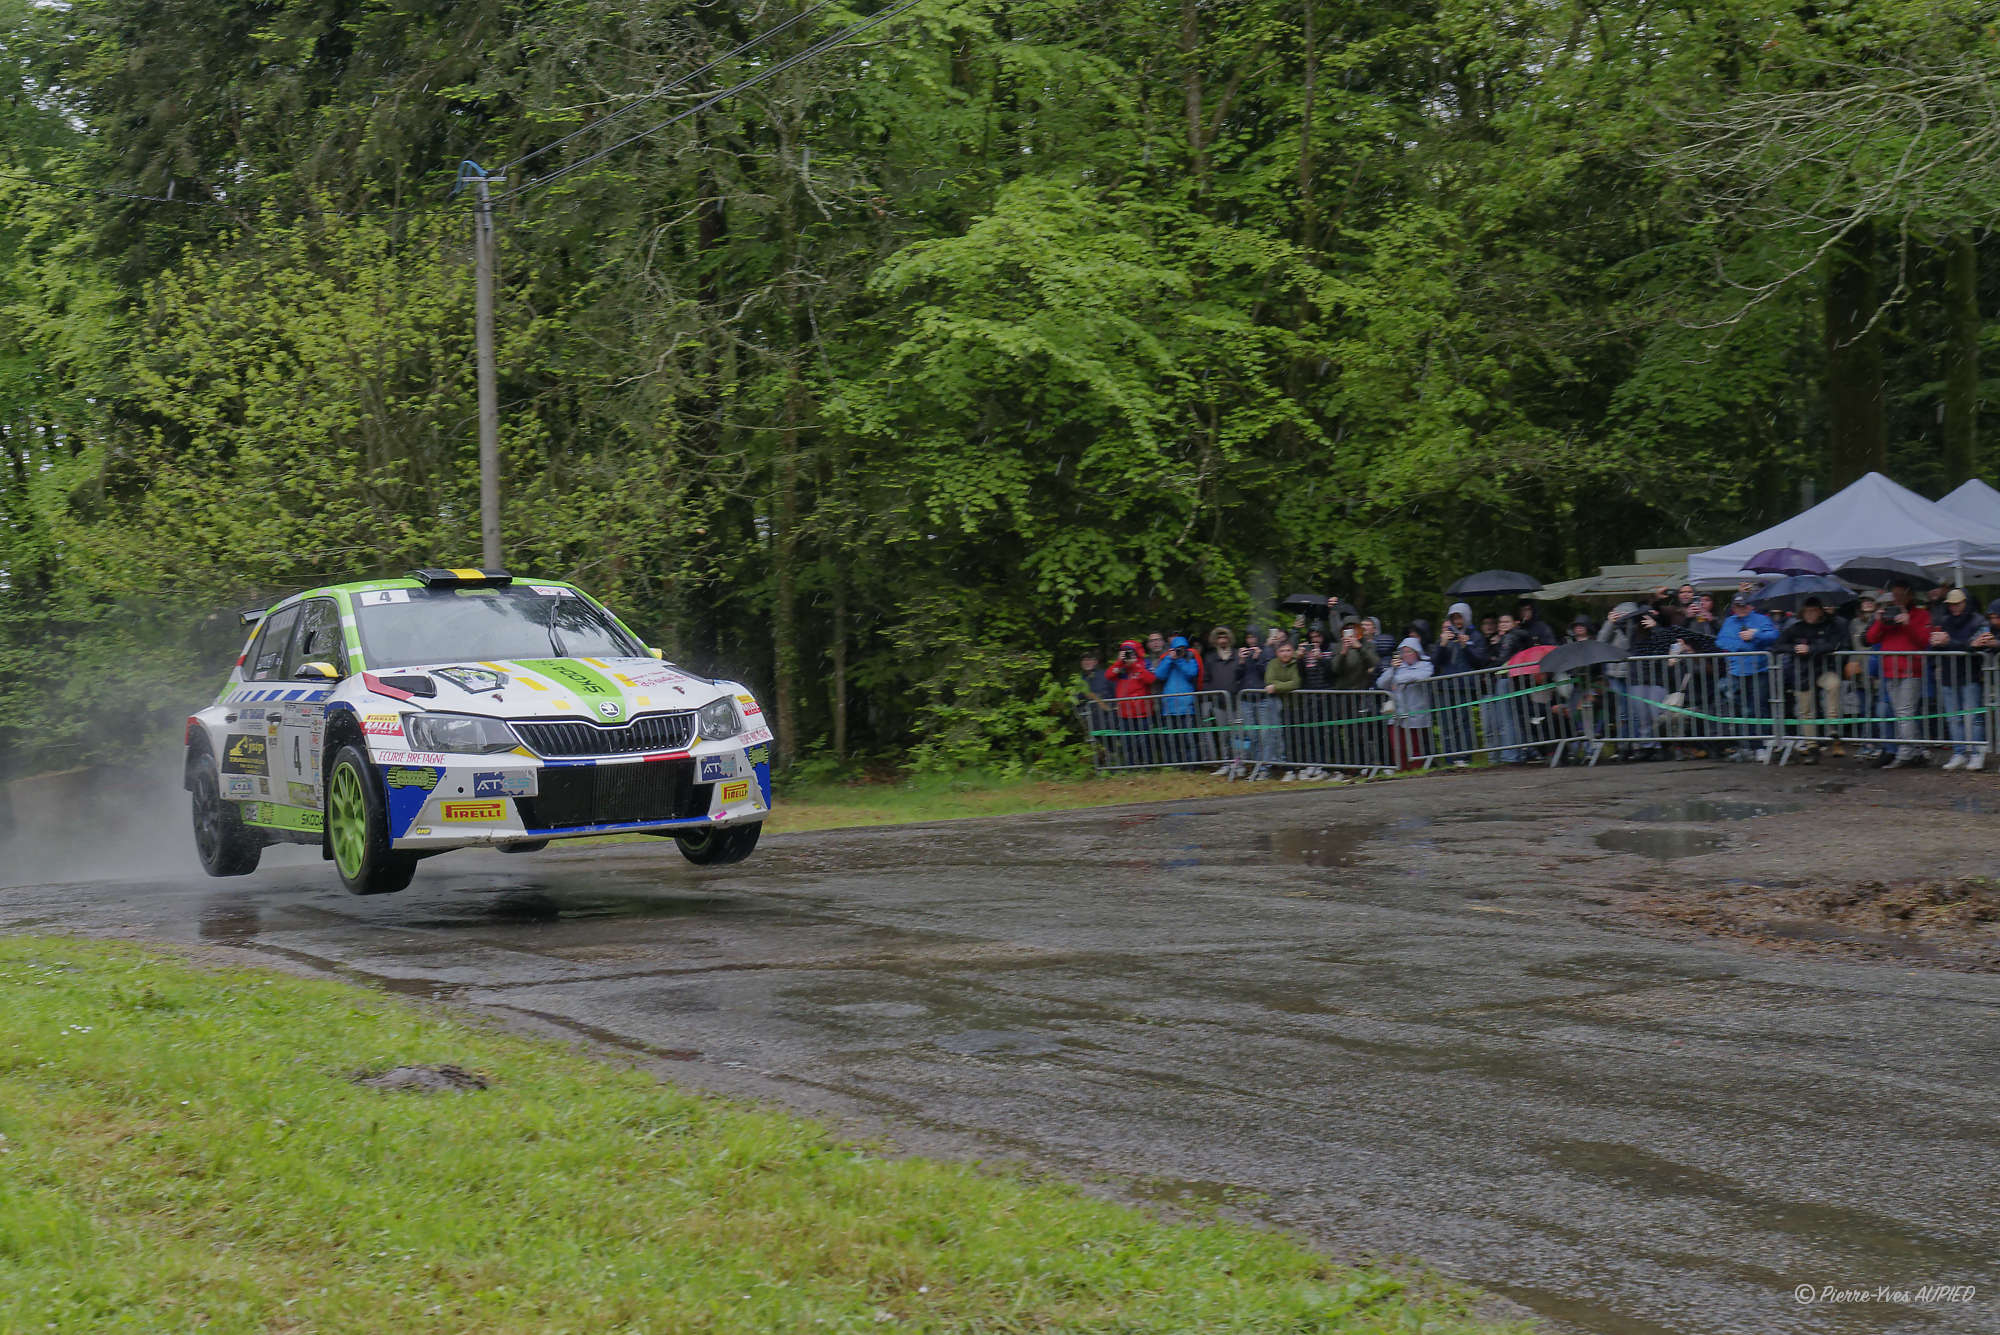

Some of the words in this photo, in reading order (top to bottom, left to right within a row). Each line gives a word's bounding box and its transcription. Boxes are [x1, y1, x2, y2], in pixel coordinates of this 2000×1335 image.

[379, 591, 391, 602] 4
[294, 735, 302, 776] 4
[378, 751, 405, 761] ECURIE
[406, 752, 446, 764] BRETAGNE
[723, 783, 749, 800] PIRELLI
[445, 803, 501, 818] PIRELLI
